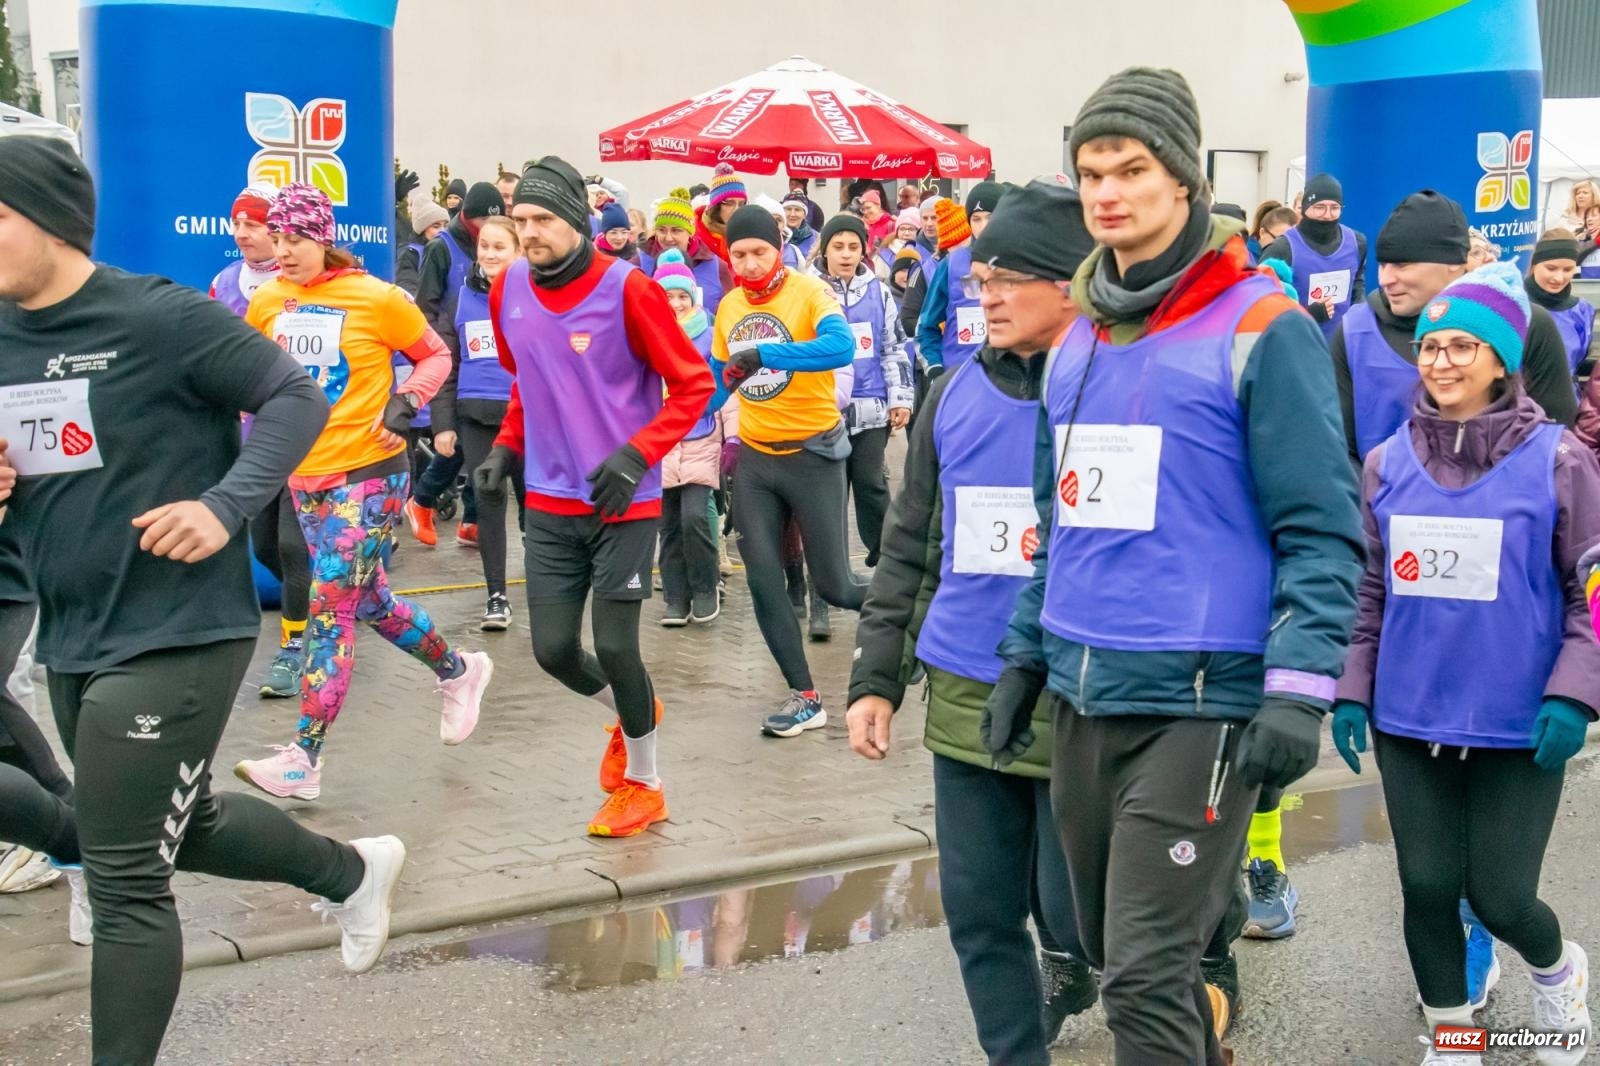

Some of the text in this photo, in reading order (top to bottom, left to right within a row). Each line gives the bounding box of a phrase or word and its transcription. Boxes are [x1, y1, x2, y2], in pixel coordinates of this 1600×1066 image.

[716, 91, 770, 135] WARKA
[813, 92, 859, 142] WARKA
[651, 138, 686, 152] WARKA
[717, 145, 761, 162] Classic
[793, 155, 838, 167] WARKA
[871, 153, 914, 170] Classic
[174, 215, 388, 244] GMIN NOWICE
[1323, 284, 1338, 298] 22
[969, 322, 986, 336] 13
[287, 334, 323, 355] 100
[20, 417, 58, 451] 75
[1087, 467, 1103, 502] 2
[990, 520, 1009, 552] 3
[1421, 548, 1460, 580] 32
[126, 730, 161, 739] hummel
[283, 770, 306, 780] HOKA
